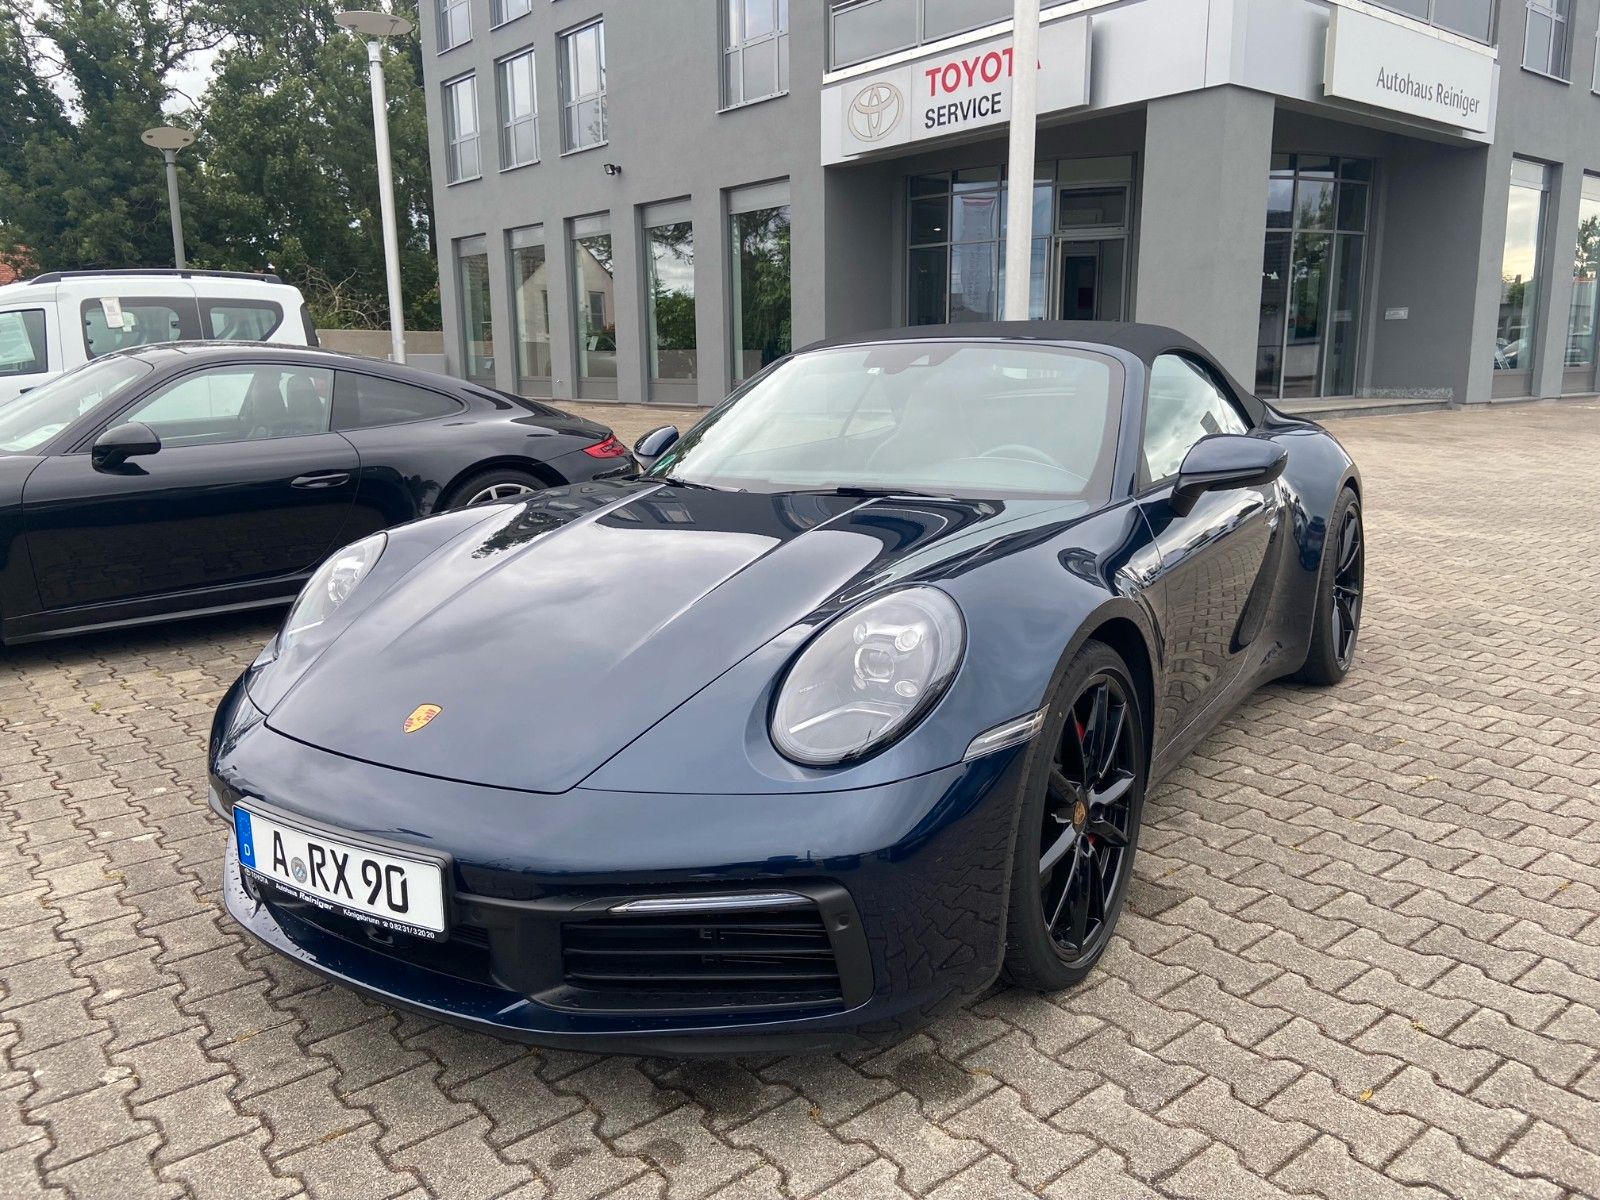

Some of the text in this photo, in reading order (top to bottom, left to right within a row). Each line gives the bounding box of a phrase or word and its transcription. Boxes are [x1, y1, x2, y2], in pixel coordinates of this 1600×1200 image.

[925, 47, 1041, 97] TOYOT
[1376, 66, 1480, 117] Autohaus Reiniger
[925, 92, 1002, 129] SERVICE
[244, 843, 250, 856] D
[273, 830, 409, 914] A RX 90
[299, 891, 334, 910] Reiniger
[343, 907, 380, 925] Königsbrunn
